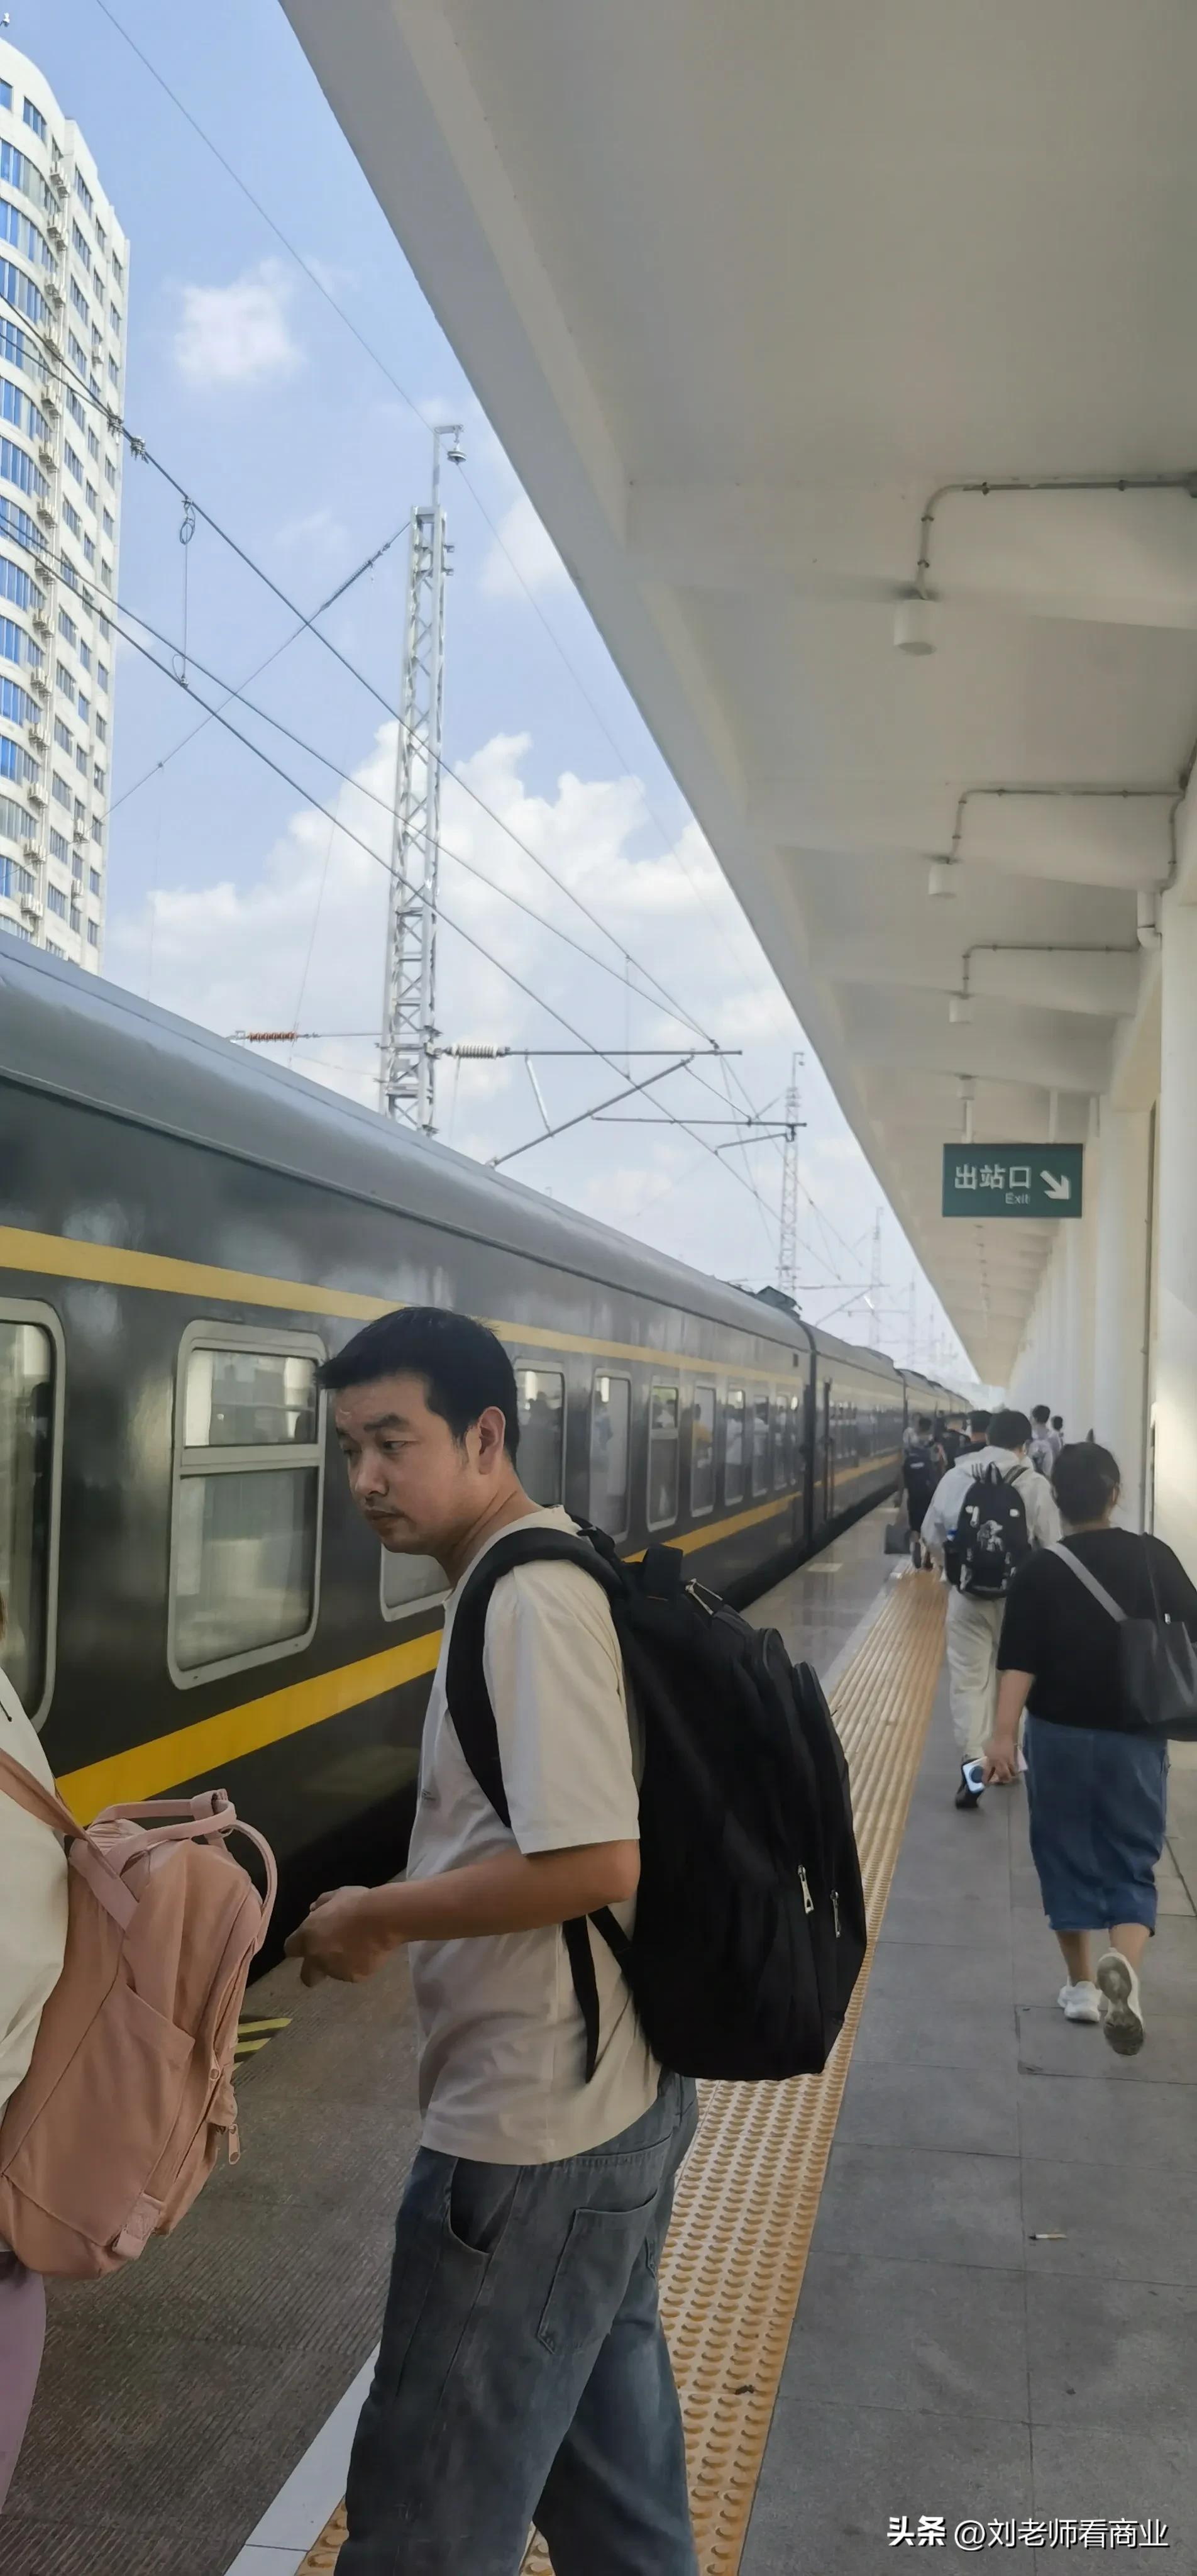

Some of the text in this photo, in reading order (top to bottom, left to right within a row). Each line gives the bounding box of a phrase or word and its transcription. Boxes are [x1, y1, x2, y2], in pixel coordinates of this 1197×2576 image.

[954, 1163, 1032, 1190] 出站口
[1005, 1192, 1030, 1204] Exit
